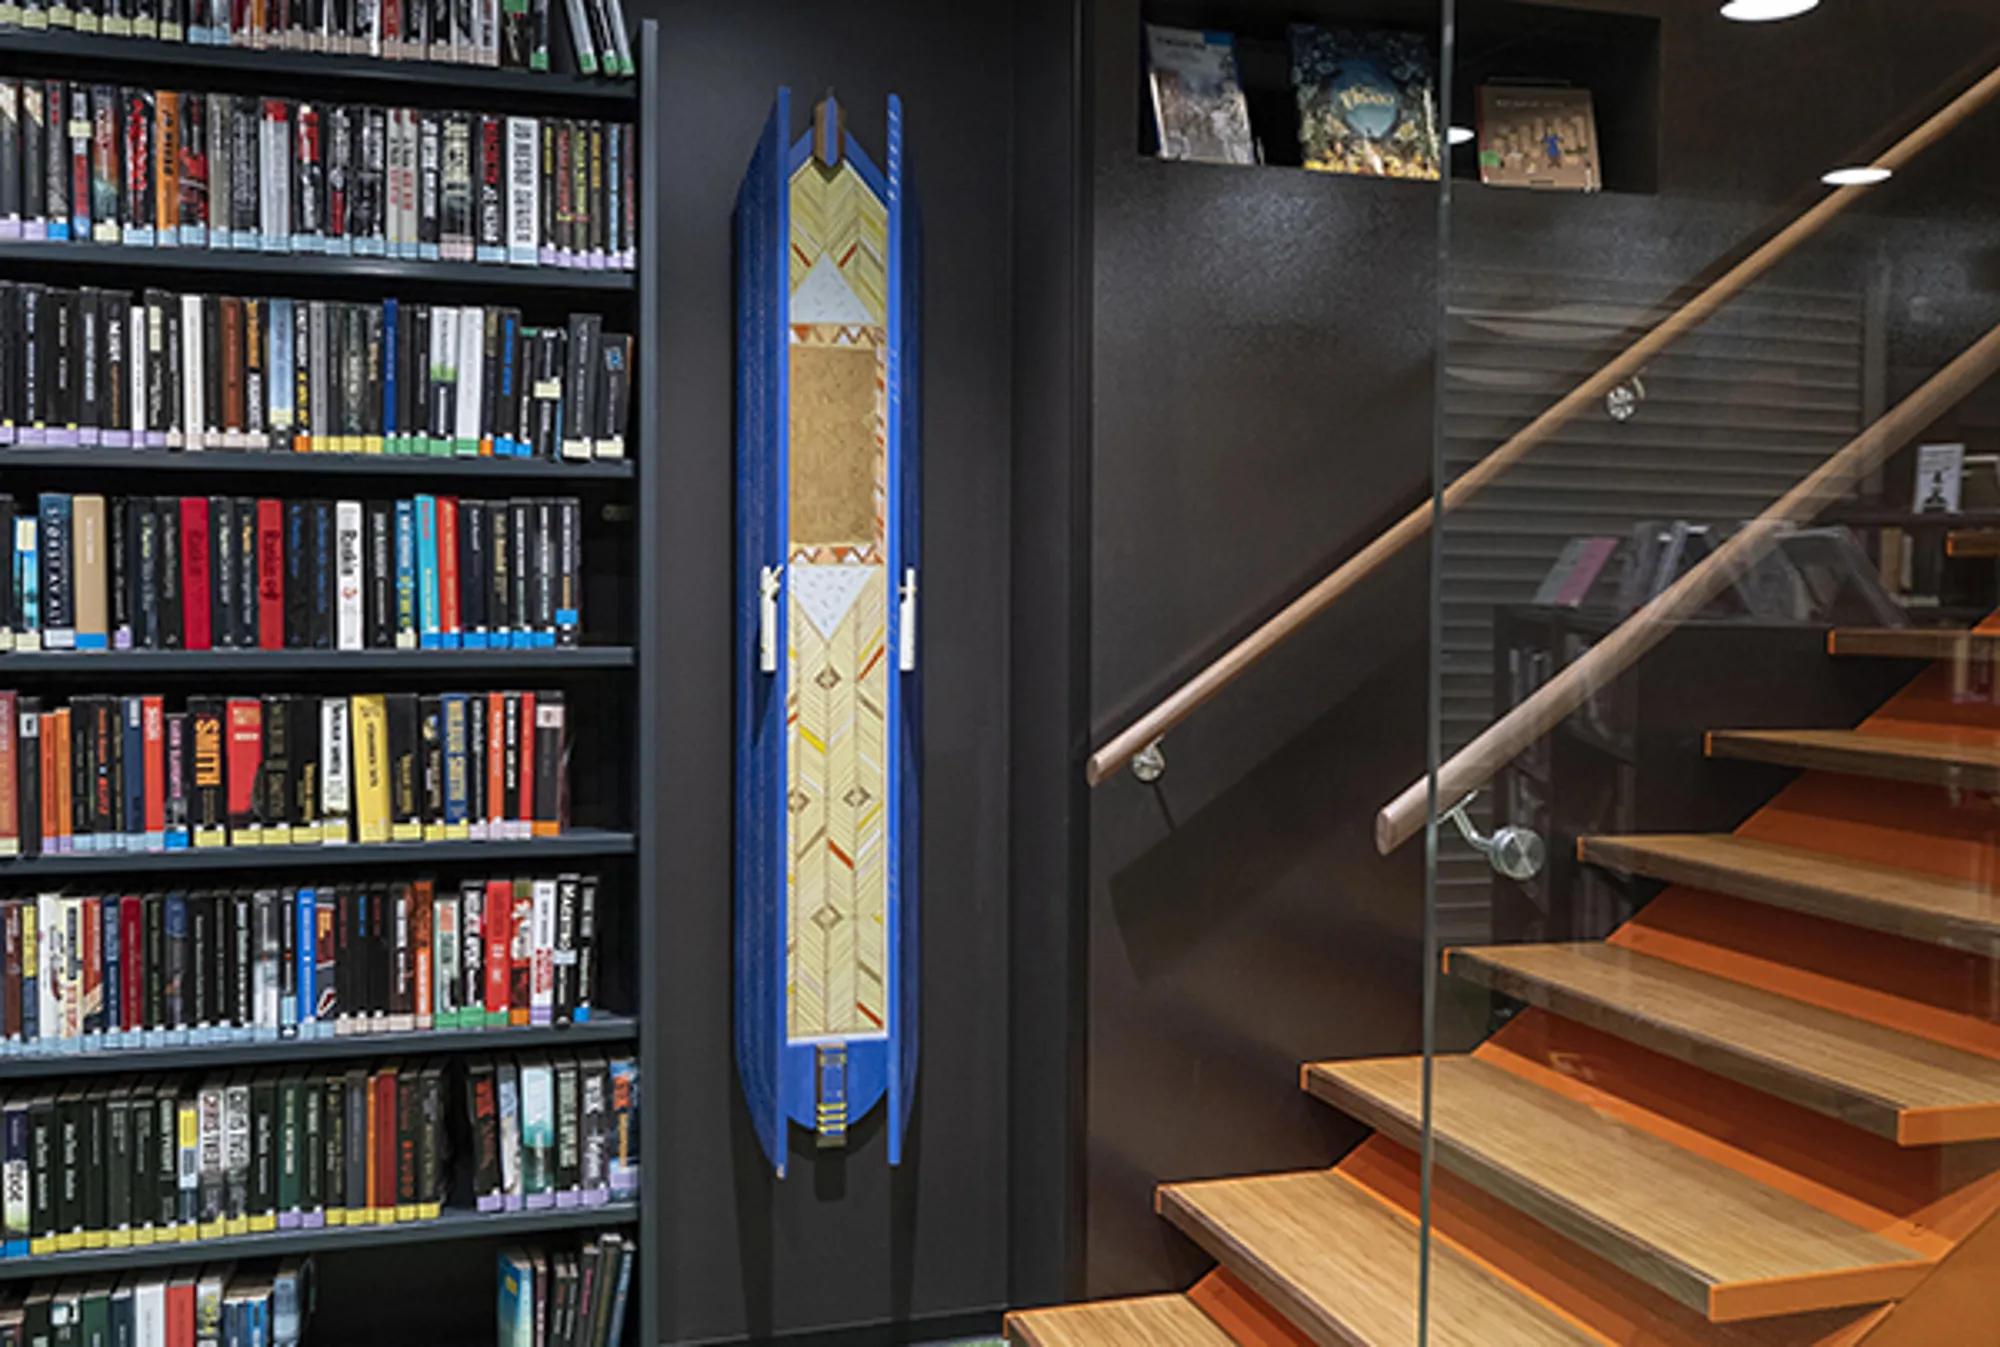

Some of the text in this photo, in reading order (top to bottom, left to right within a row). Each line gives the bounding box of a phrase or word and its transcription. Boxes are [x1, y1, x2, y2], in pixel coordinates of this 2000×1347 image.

[340, 530, 358, 576] Rankin
[195, 718, 221, 786] SMITH
[559, 884, 575, 949] MAESTRO
